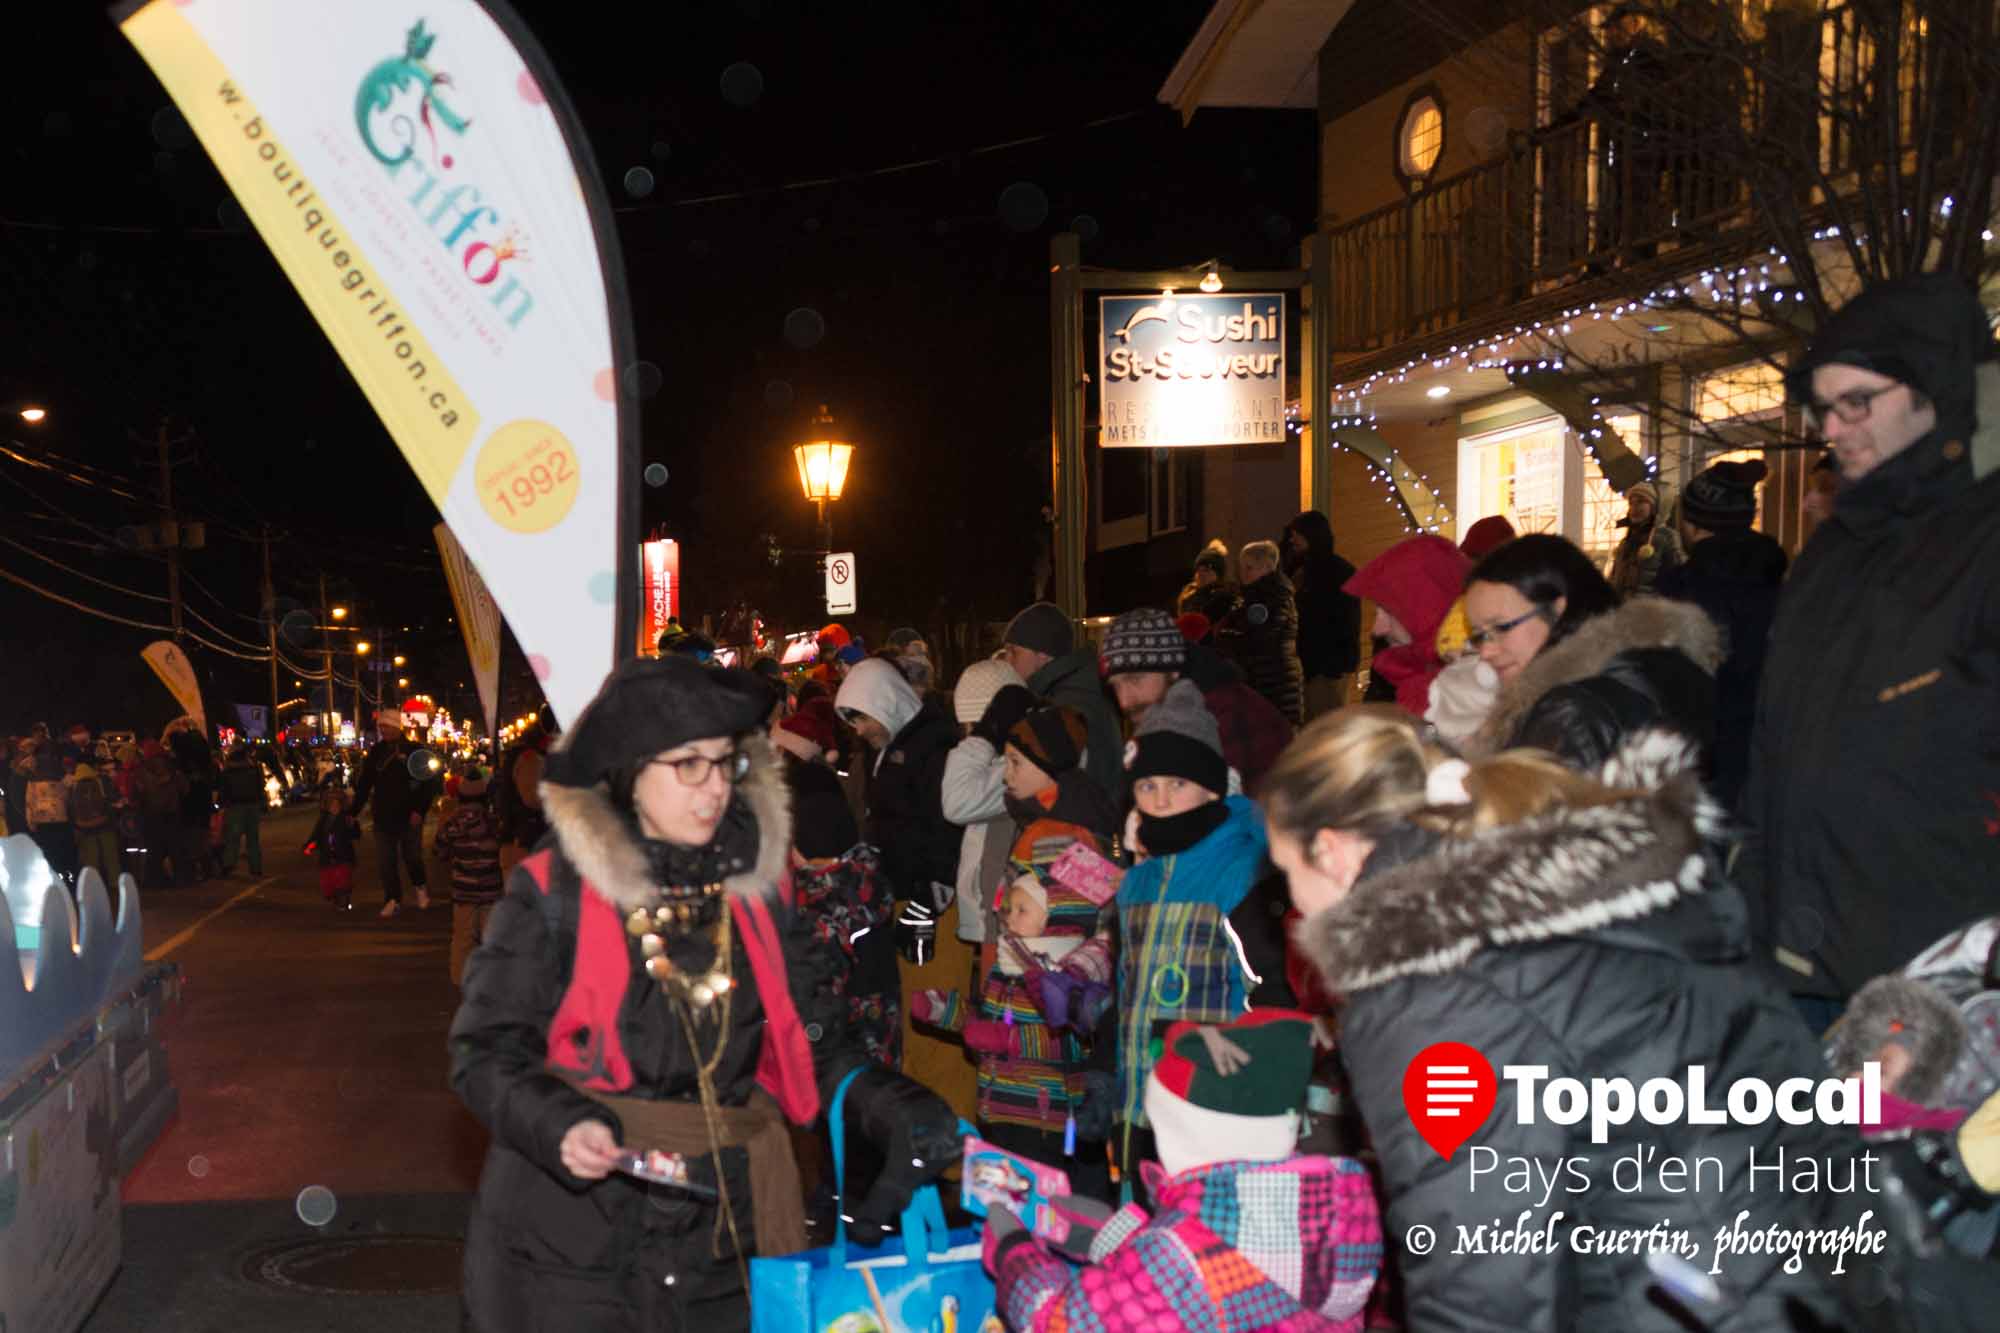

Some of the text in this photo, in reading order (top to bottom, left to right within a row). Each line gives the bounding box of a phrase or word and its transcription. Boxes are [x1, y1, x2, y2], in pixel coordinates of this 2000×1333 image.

[1175, 303, 1277, 344] Sushi
[1106, 347, 1281, 379] St-Sveur
[495, 450, 576, 517] 1992
